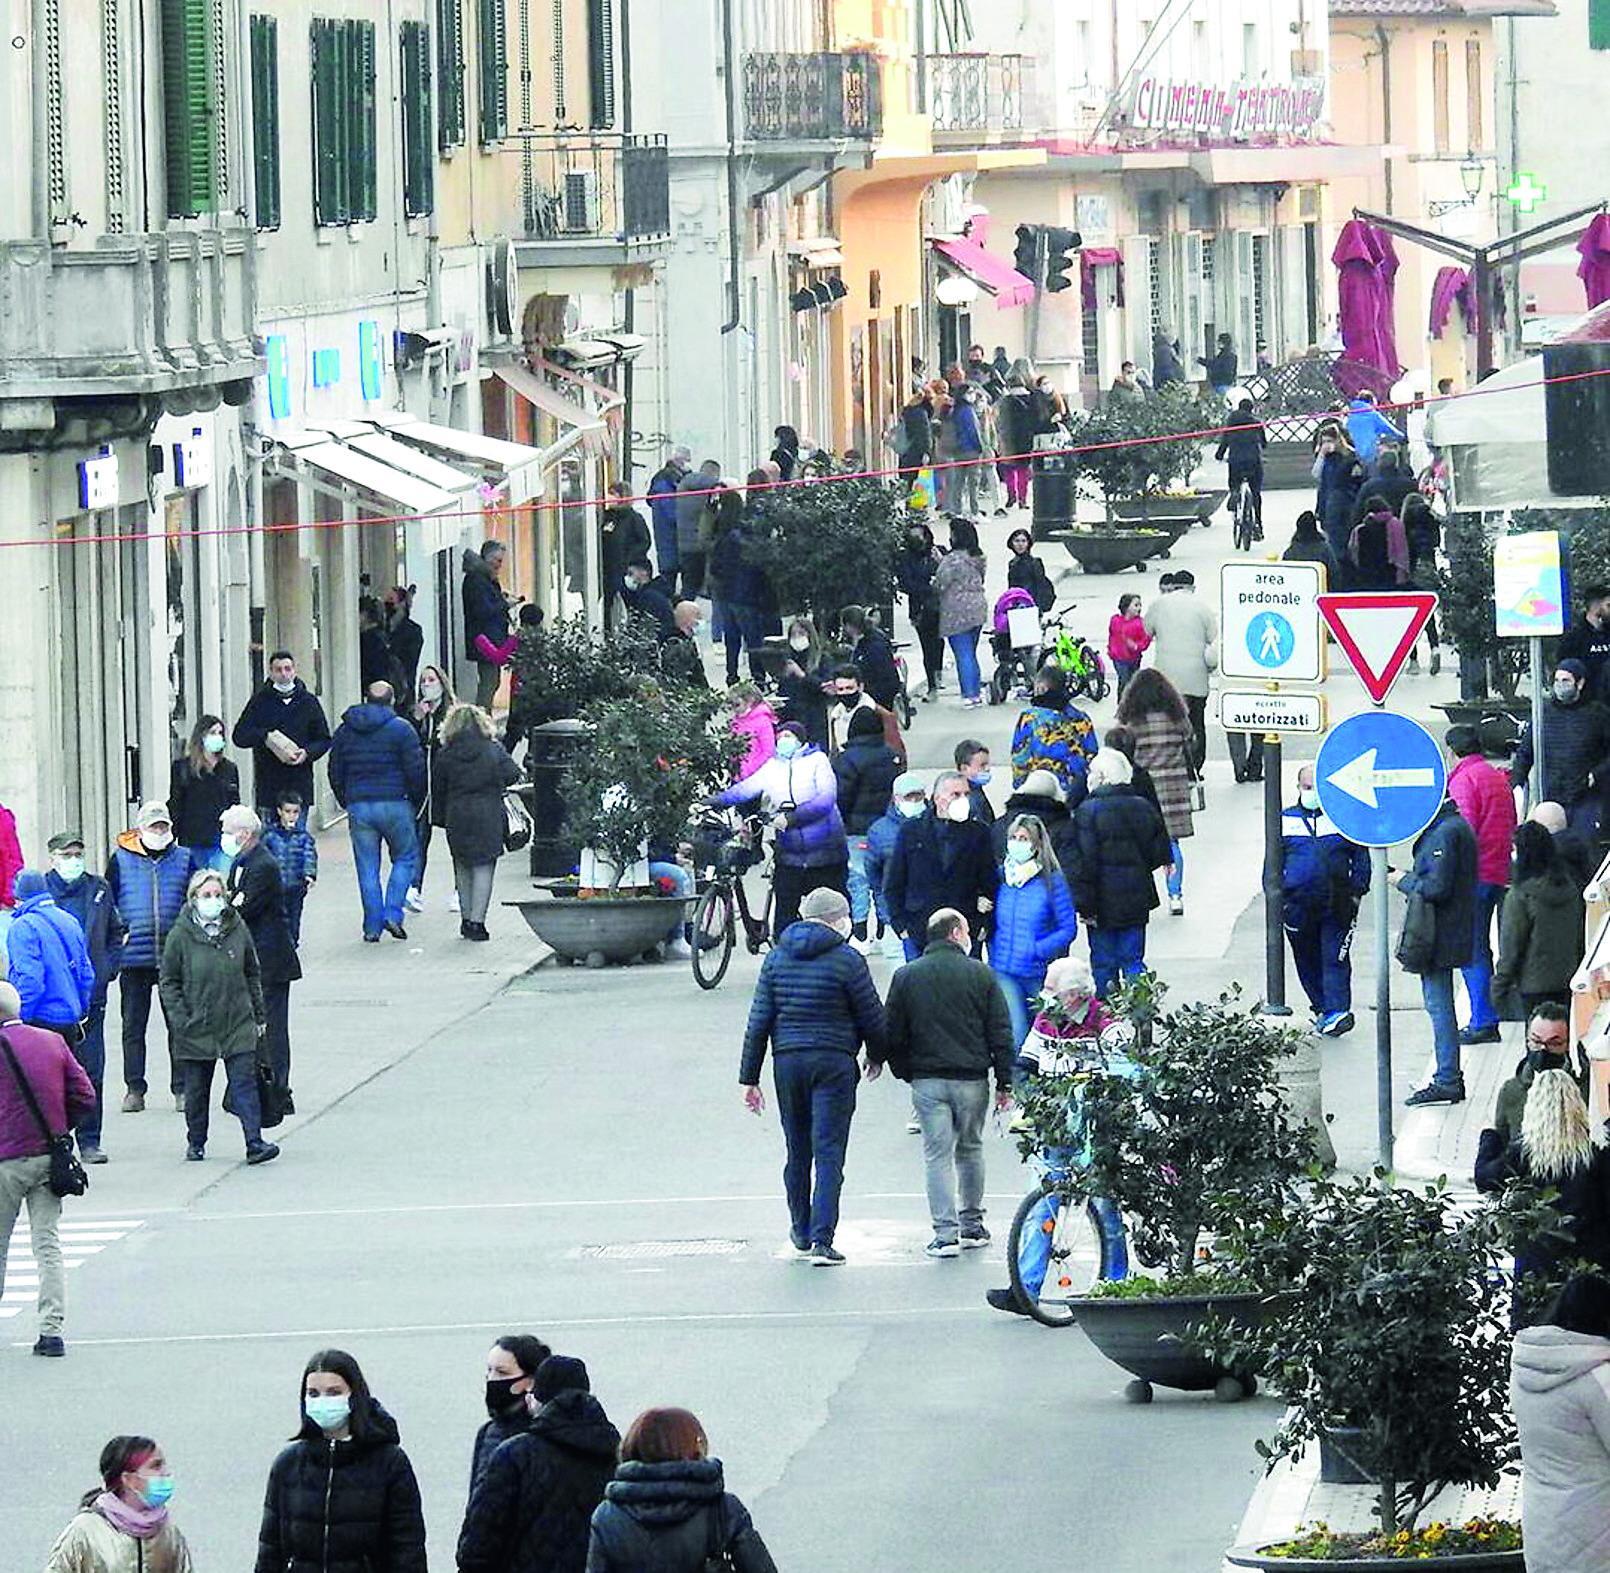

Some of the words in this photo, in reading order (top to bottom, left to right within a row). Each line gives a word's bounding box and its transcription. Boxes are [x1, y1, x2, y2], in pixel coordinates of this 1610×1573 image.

[1255, 574, 1284, 585] area
[1239, 591, 1301, 605] pedonale
[1234, 712, 1309, 726] autorizzati
